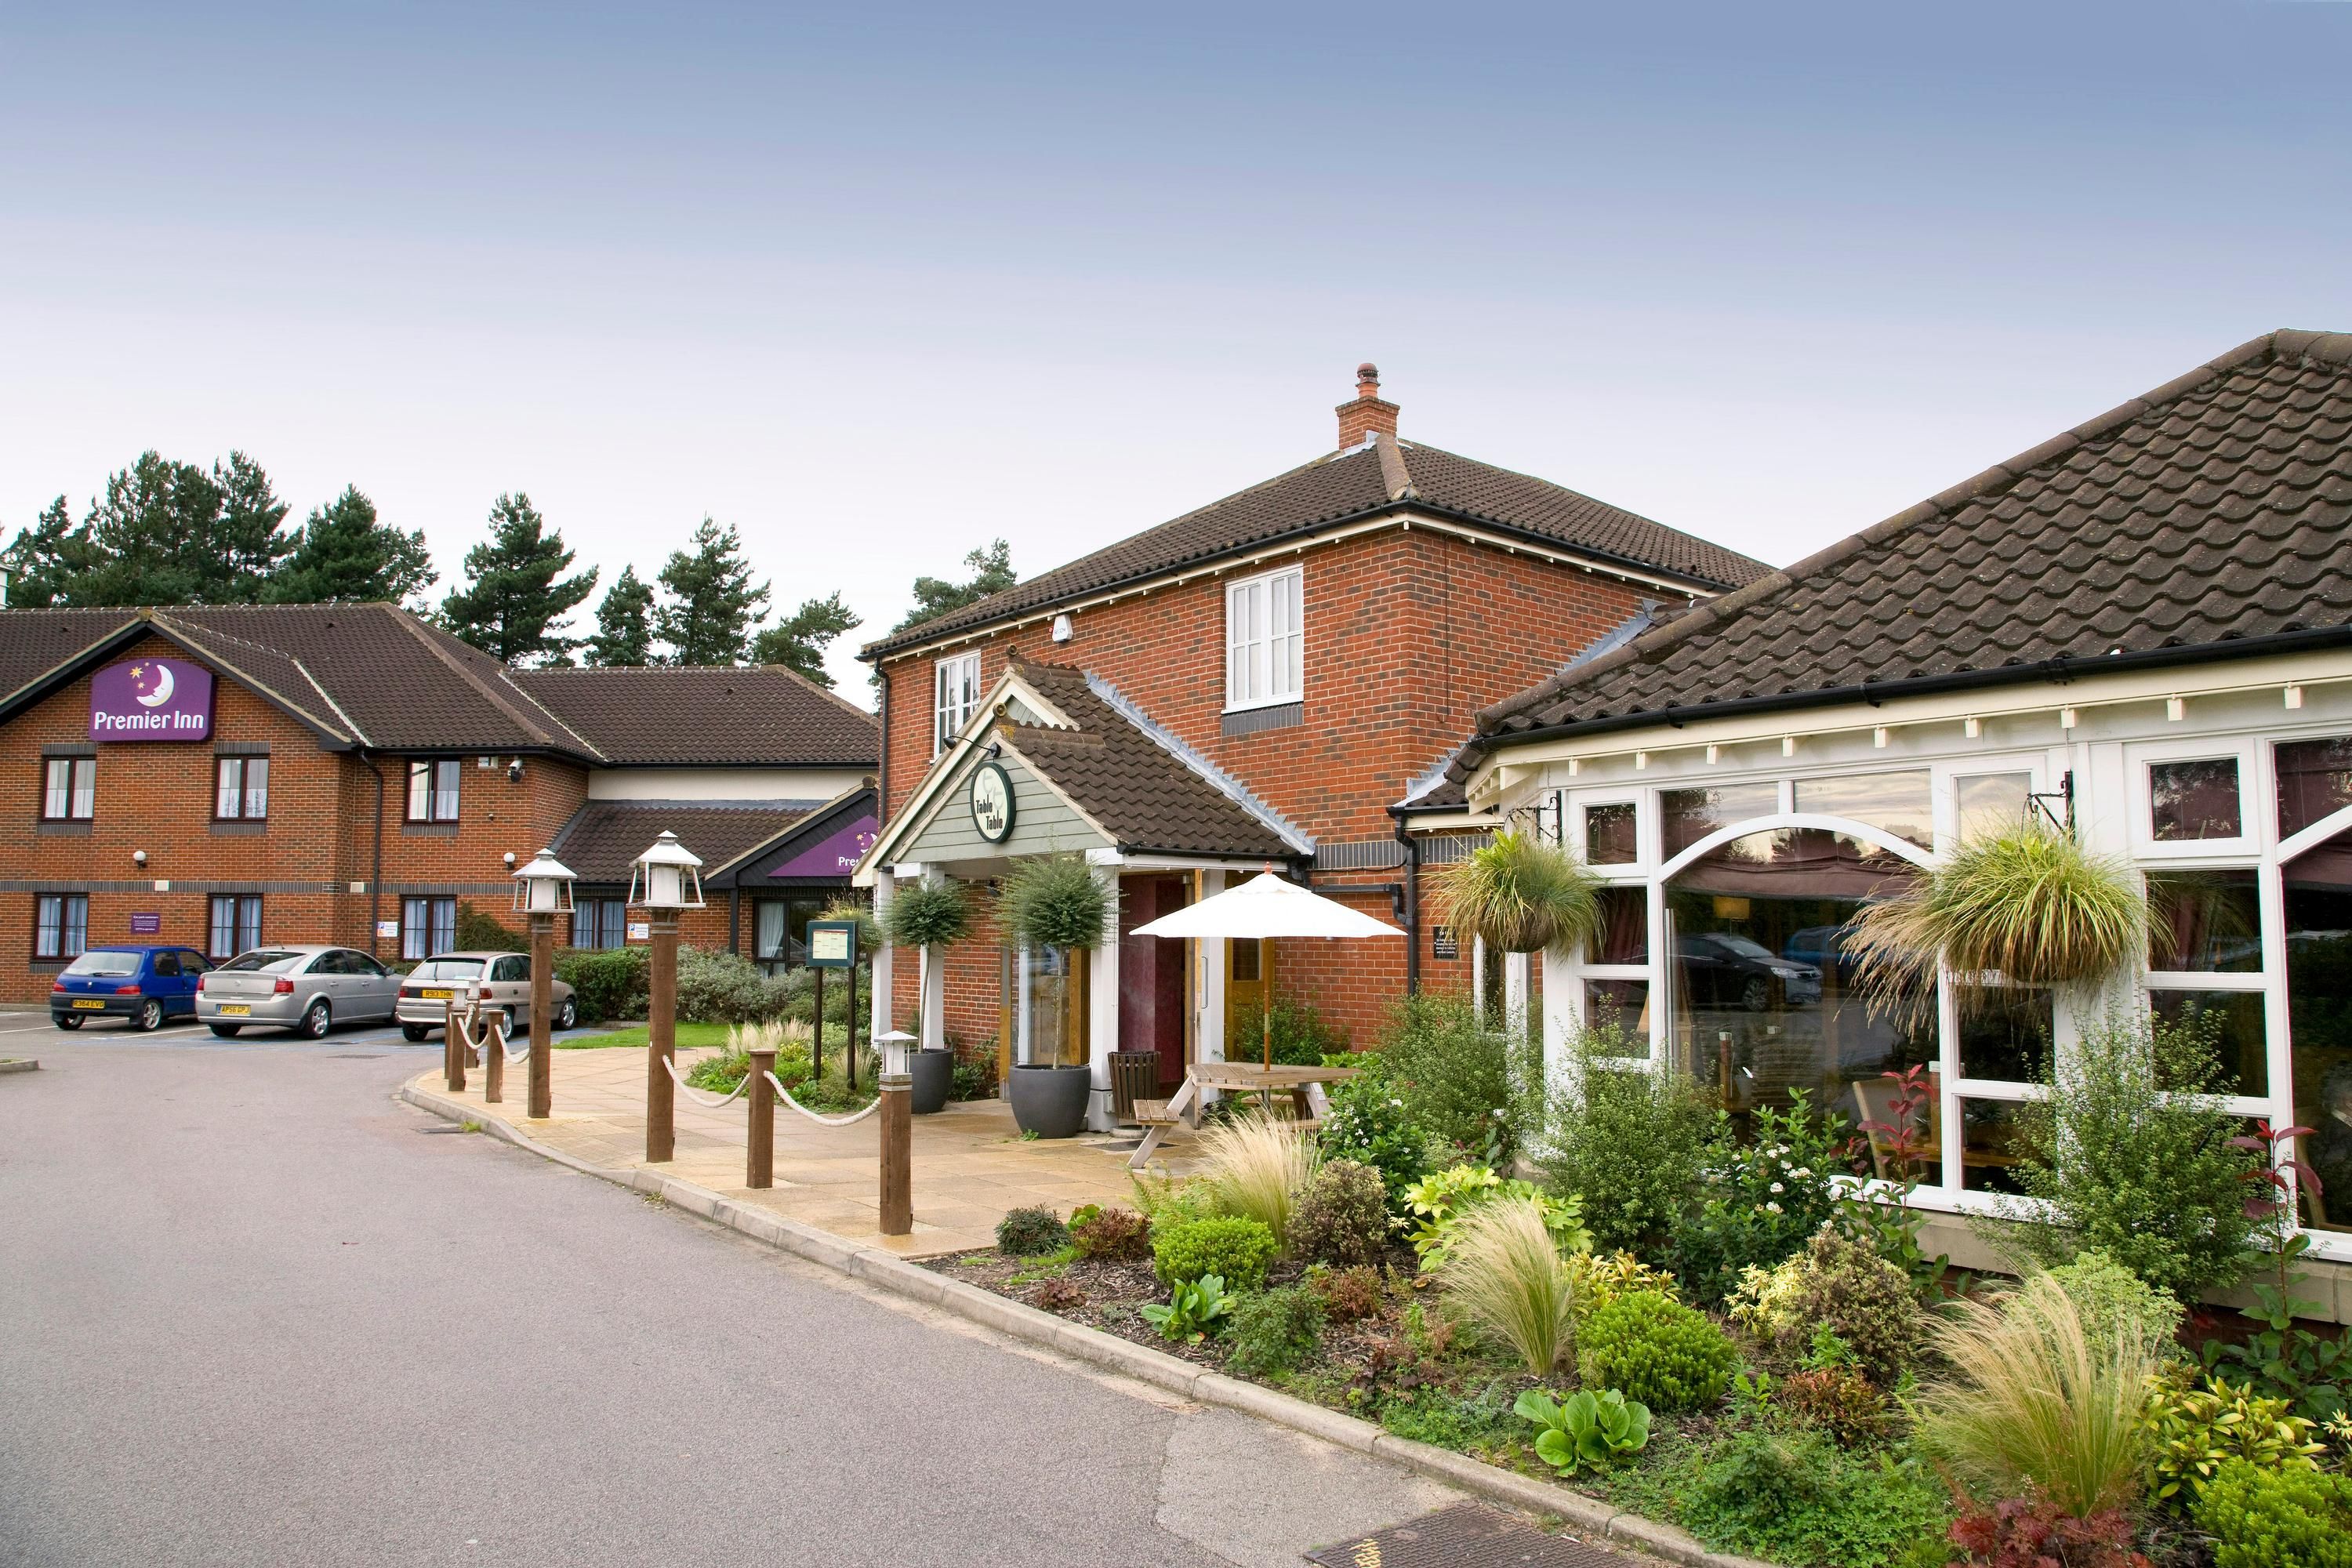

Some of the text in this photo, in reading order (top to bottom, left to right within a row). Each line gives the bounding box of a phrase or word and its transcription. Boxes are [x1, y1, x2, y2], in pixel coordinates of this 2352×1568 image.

[94, 710, 204, 730] Premier Inn
[976, 793, 993, 814] Table
[985, 810, 1004, 830] Table
